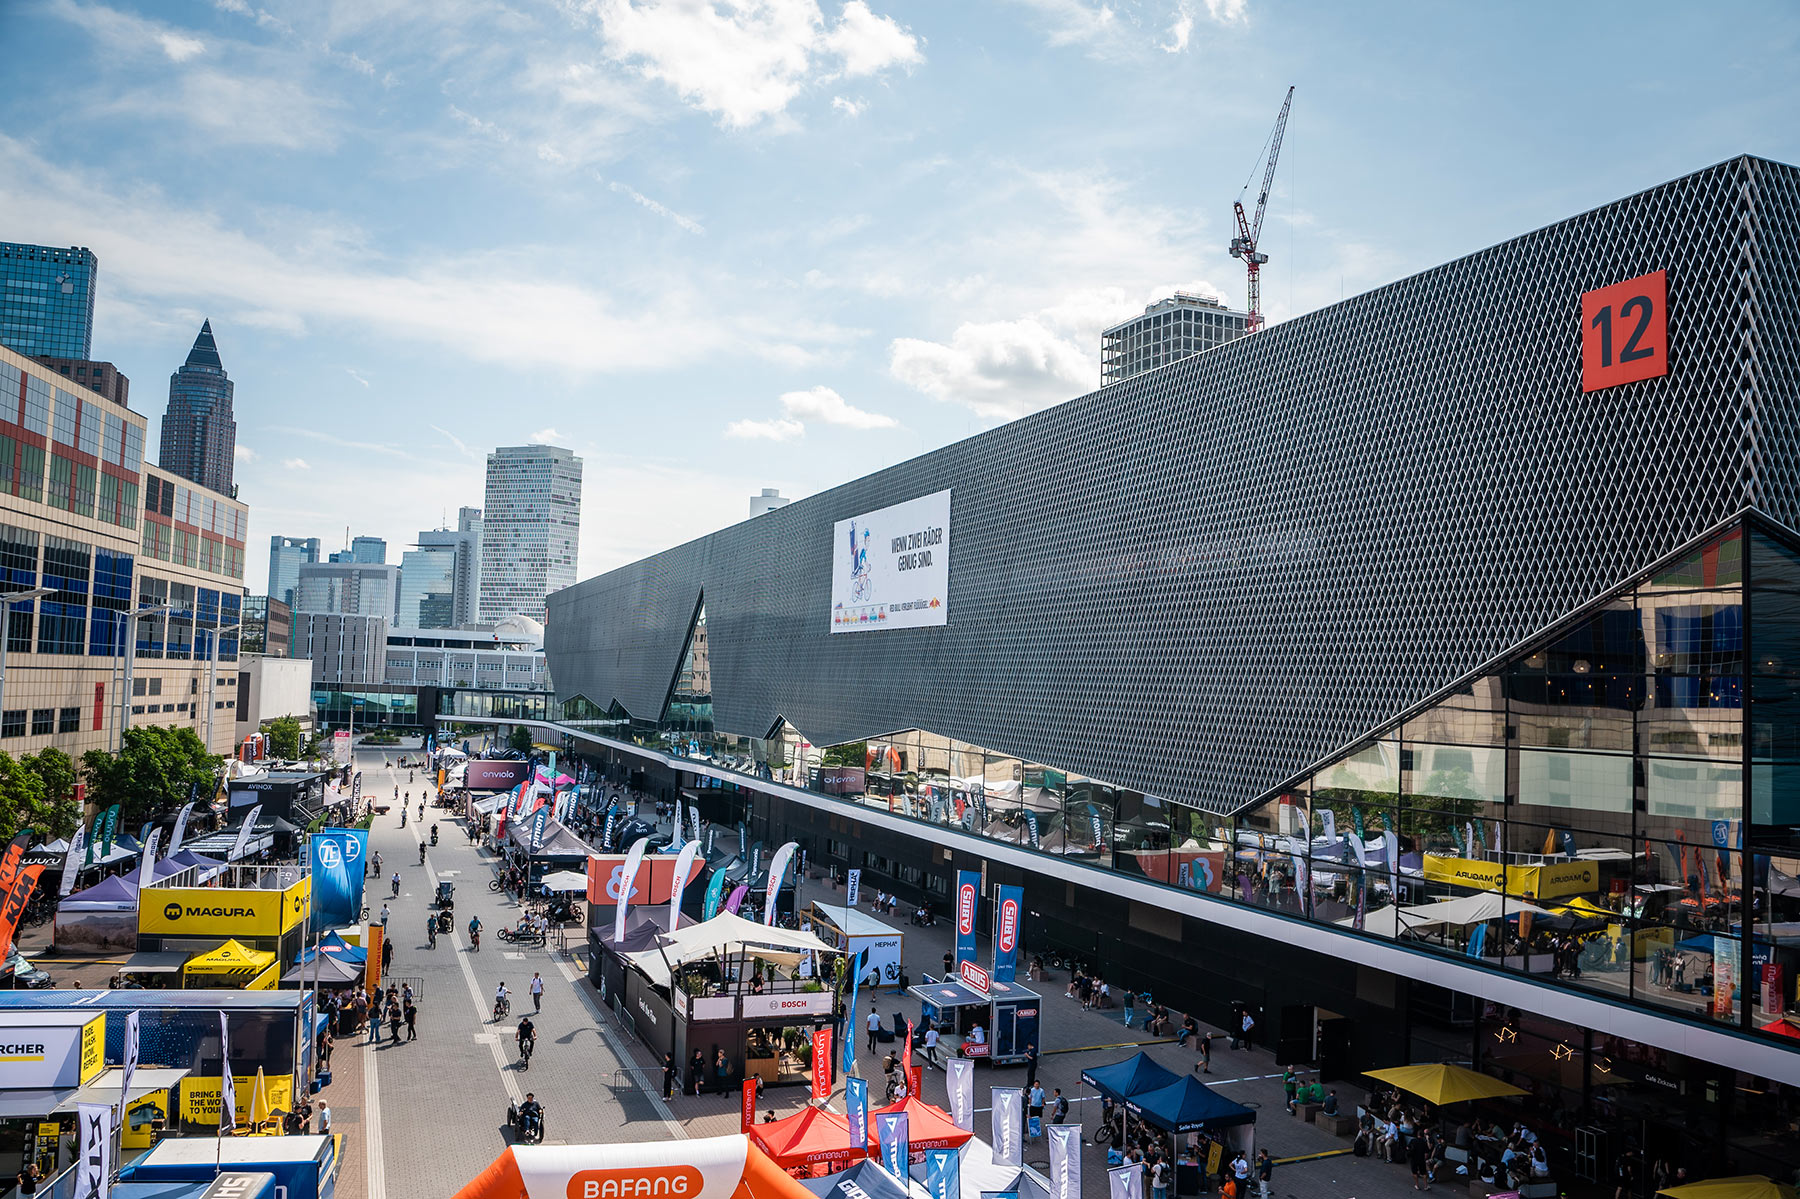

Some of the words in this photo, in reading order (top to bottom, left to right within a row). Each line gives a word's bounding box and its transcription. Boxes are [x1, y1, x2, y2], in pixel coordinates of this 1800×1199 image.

[1592, 296, 1654, 368] 12
[892, 536, 907, 553] WENN
[908, 532, 922, 550] ZWEI
[923, 526, 942, 547] RÄDER
[898, 553, 916, 571] GENUG
[918, 551, 932, 568] SIND.
[483, 770, 515, 779] enviolo
[247, 783, 272, 791] AVINOX
[507, 791, 518, 818] pinion
[568, 792, 578, 819] pinion
[532, 814, 544, 848] pinion
[604, 814, 614, 848] pinion
[751, 848, 759, 876] Panasonic
[620, 875, 630, 896] BOSCH
[673, 875, 681, 897] BOSCH
[768, 875, 777, 896] BOSCH
[6, 873, 36, 927] KTM
[186, 907, 256, 917] MAGURA
[961, 889, 971, 930] ABUS
[1003, 905, 1015, 946] ABUS
[963, 965, 986, 989] ABUS
[189, 1091, 214, 1099] BRING
[190, 1099, 205, 1107] THE
[1179, 1124, 1190, 1132] Selle
[807, 1150, 850, 1162] momentum
[584, 1175, 688, 1199] BAFANG
